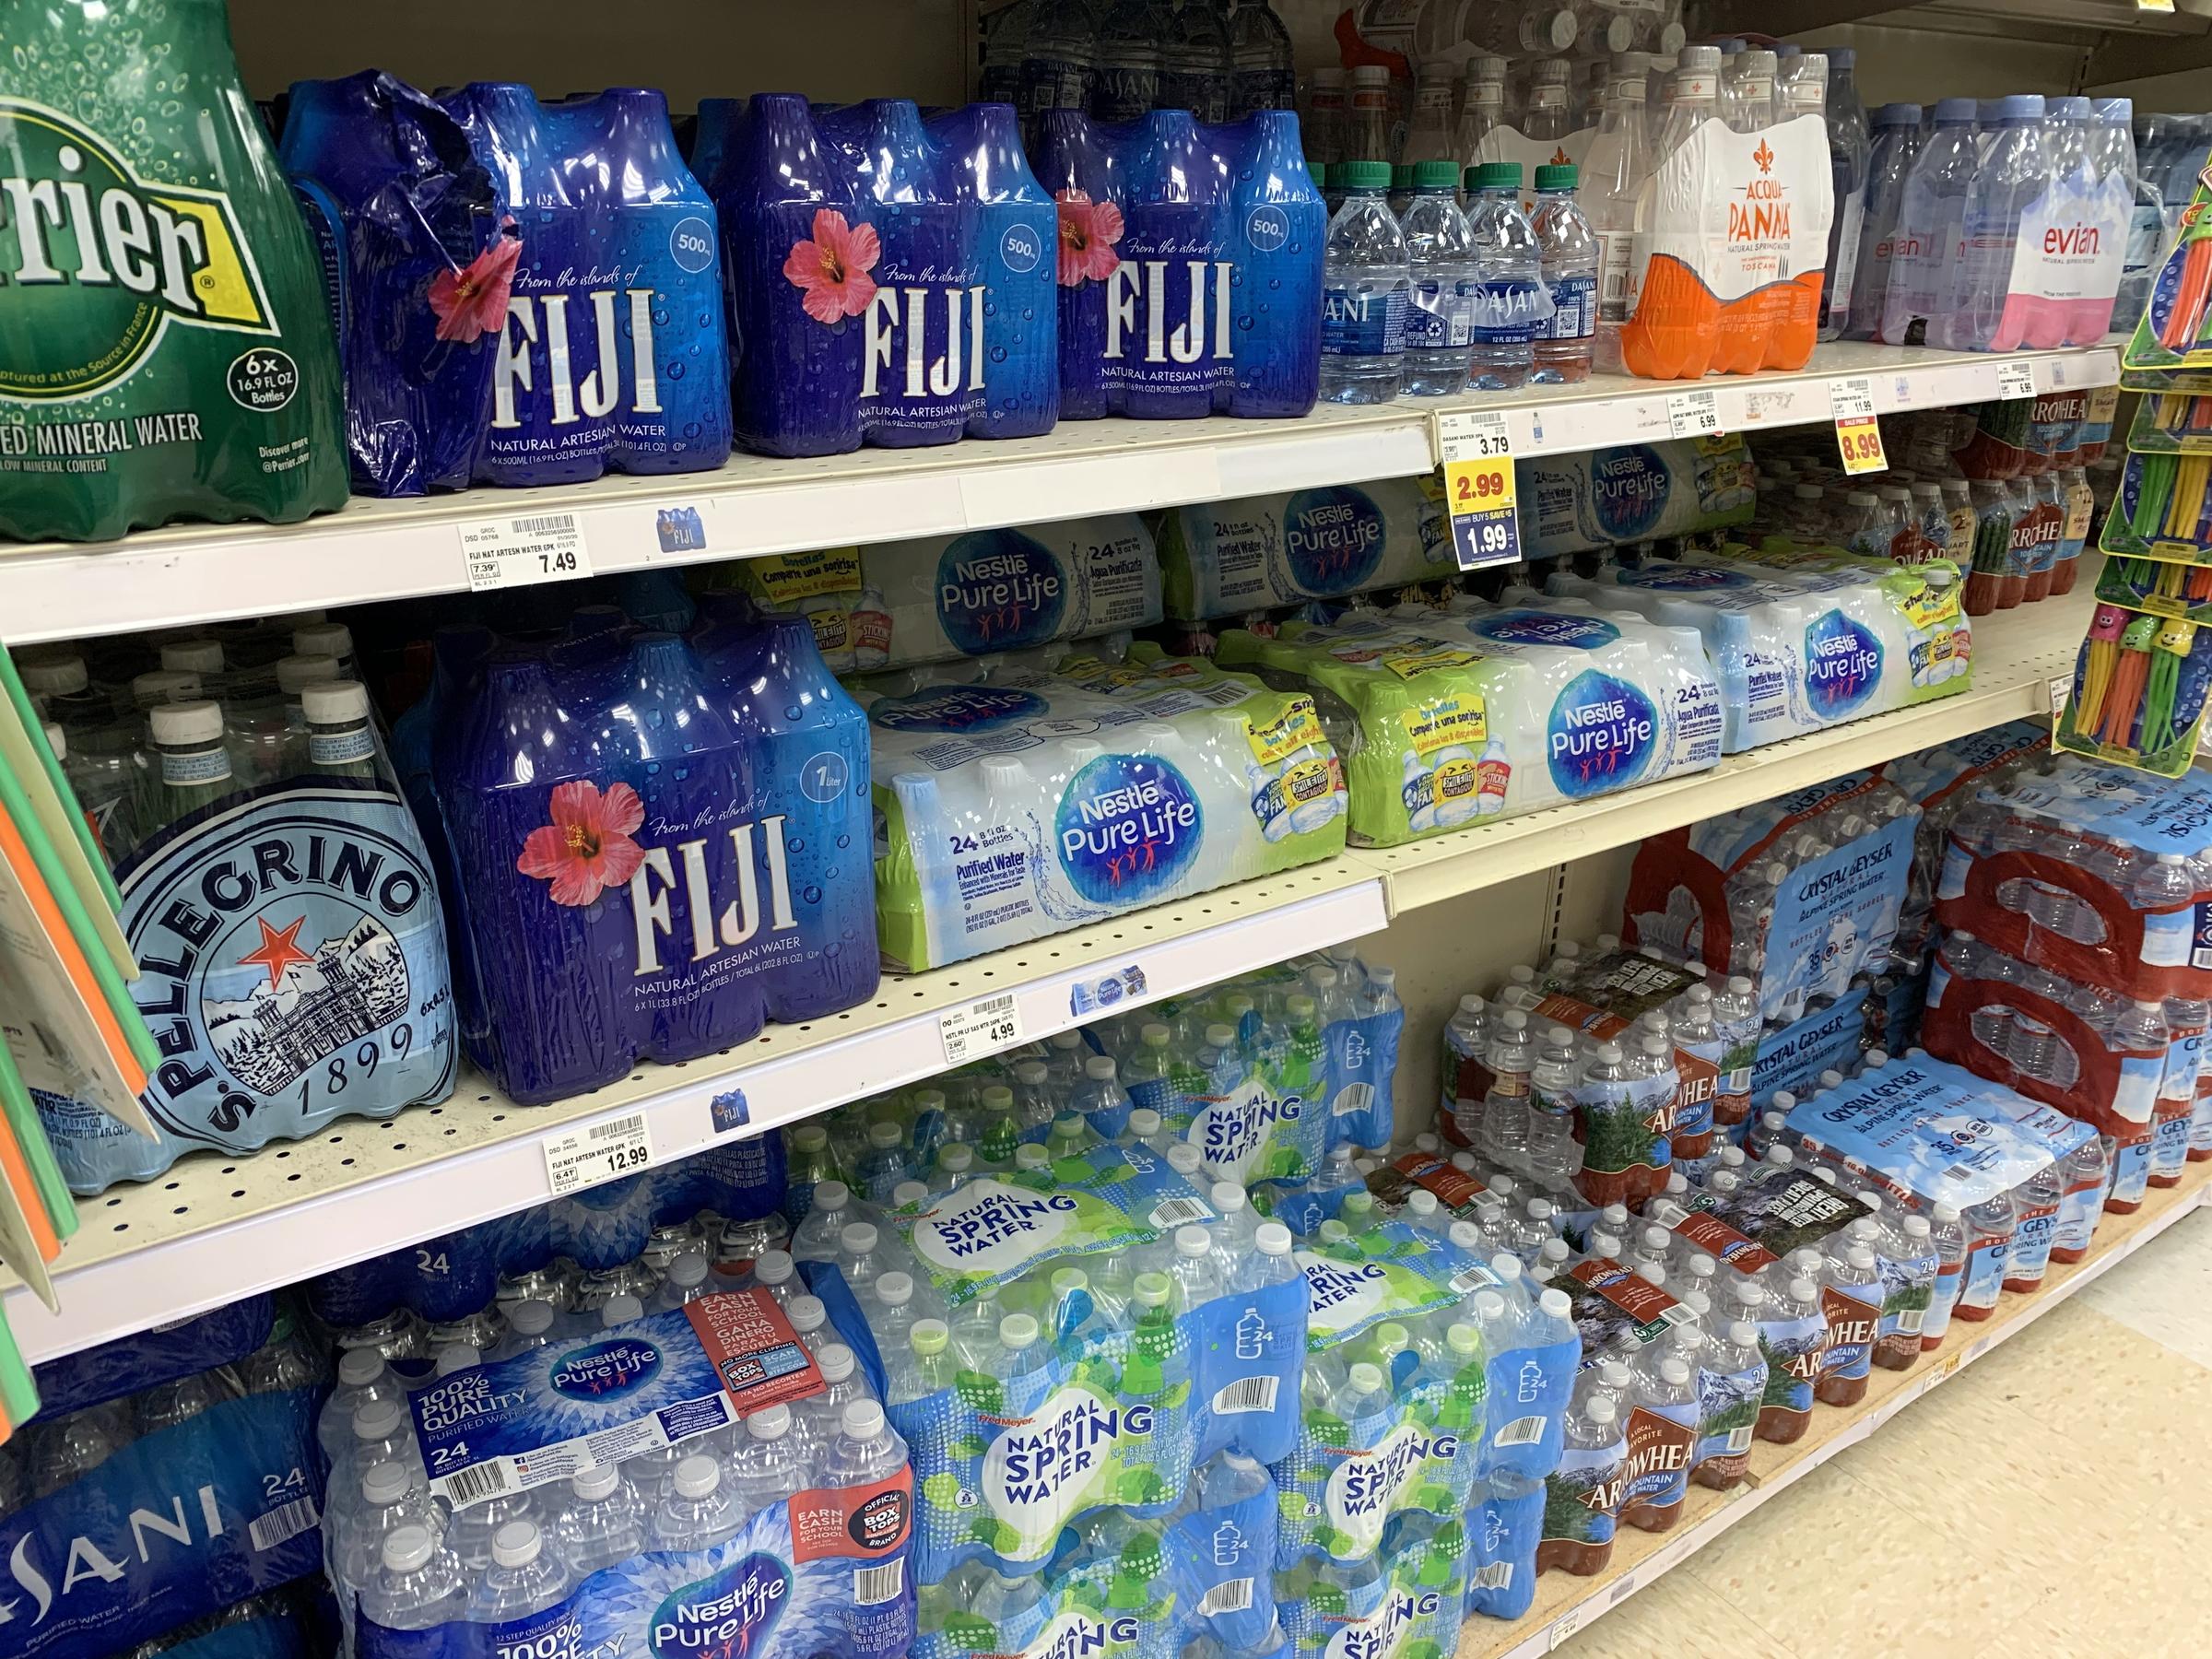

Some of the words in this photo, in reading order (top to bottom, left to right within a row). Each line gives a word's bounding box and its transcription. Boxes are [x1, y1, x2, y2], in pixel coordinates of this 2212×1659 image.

[1747, 181, 1783, 200] ACQUA
[0, 146, 199, 312] rier
[1728, 202, 1791, 242] PANNA
[1126, 238, 1154, 253] From
[1158, 238, 1177, 253] the
[1179, 238, 1211, 255] islands
[2044, 221, 2100, 254] evian
[884, 264, 915, 281] From
[919, 265, 936, 282] the
[1103, 261, 1234, 363] FIJI
[859, 285, 986, 399] FIJI
[49, 372, 64, 383] at
[88, 346, 124, 372] Source
[490, 288, 664, 429] FIJI
[237, 378, 262, 391] 16.9
[265, 376, 276, 388] FL
[277, 372, 293, 385] OZ
[1101, 367, 1146, 381] NATURAL
[1148, 369, 1201, 382] ARTESIAN
[1204, 367, 1234, 379] WATER
[252, 389, 285, 404] Bottles
[2020, 382, 2032, 394] 6.99
[858, 406, 906, 419] NATURAL
[909, 404, 958, 418] ARTESIAN
[959, 397, 986, 412] WATER
[1855, 400, 1872, 412] 11.99
[1700, 415, 1715, 428] 6.99
[36, 419, 133, 455] MINERAL
[135, 413, 203, 446] WATER
[490, 438, 557, 453] NATURAL
[561, 424, 616, 448] ARTESIAN
[618, 424, 666, 439] WATER
[259, 445, 290, 457] Discover
[291, 437, 309, 448] more
[1480, 437, 1509, 455] 3.79
[1842, 432, 1880, 461] 8.99
[23, 460, 65, 473] MINERAL
[66, 459, 107, 473] CONTENT
[1457, 472, 1504, 500] 2.99
[1472, 513, 1485, 523] BUY
[1489, 511, 1505, 520] SAVE
[1214, 523, 1230, 537] 24
[1288, 529, 1341, 555] Pure
[1343, 520, 1380, 553] Life
[1467, 524, 1507, 555] 1.99
[469, 552, 481, 560] FIJI
[482, 550, 495, 559] NAT
[497, 547, 520, 558] ARTESN
[521, 545, 542, 555] WATER
[1088, 543, 1115, 560] 24
[538, 552, 577, 574] 7.49
[943, 582, 1009, 613] Pure
[1014, 572, 1060, 610] Life
[1808, 657, 1849, 682] Pure
[1850, 650, 1878, 682] Life
[1677, 685, 1701, 704] 24
[1565, 700, 1627, 730] Nestlé
[1677, 709, 1693, 724] Agua
[1551, 732, 1609, 759] Pure
[1611, 718, 1652, 755] Life
[1078, 779, 1160, 825] Nestlé
[982, 831, 1014, 849] Bottles
[1061, 815, 1139, 862] Pure
[1142, 799, 1195, 845] Life
[949, 833, 979, 854] 24
[956, 858, 994, 880] Purified
[995, 851, 1025, 872] Water
[629, 815, 798, 977] FIJI
[634, 978, 697, 997] NATURAL
[700, 946, 759, 981] ARTESIAN
[761, 935, 802, 955] WATER
[991, 1022, 1015, 1042] 4.99
[1746, 1019, 1760, 1033] 24
[1355, 1045, 1371, 1056] 24
[300, 1023, 412, 1117] 1899
[1822, 1093, 1881, 1123] CRYSTAL
[1871, 1067, 1928, 1098] GEYSER
[1206, 1096, 1302, 1147] SPRING
[563, 1159, 574, 1168] NAT
[575, 1153, 596, 1164] ARTESN
[596, 1147, 615, 1158] WATER
[607, 1146, 648, 1172] 12.99
[932, 1192, 1020, 1230] NATURAL
[938, 1194, 1077, 1246] SPRING
[948, 1219, 1038, 1259] WATER
[416, 1249, 451, 1276] 24
[1921, 1259, 1936, 1274] 24
[700, 1291, 754, 1307] EARN
[705, 1300, 758, 1314] CASH
[711, 1312, 766, 1329] SCHOOL
[730, 1306, 760, 1317] YOUR
[716, 1319, 771, 1339] GANA
[720, 1325, 775, 1346] DINERO
[1252, 1328, 1274, 1344] 24
[721, 1358, 734, 1368] NO
[735, 1351, 758, 1362] MORE
[759, 1341, 795, 1355] CLIPPING
[726, 1337, 781, 1357] ESCUELA
[764, 1348, 797, 1362] SCAN
[554, 1362, 614, 1388] Pure
[616, 1349, 656, 1381] Life
[728, 1361, 757, 1379] BOX
[735, 1366, 764, 1382] TOPS
[1752, 1366, 1767, 1382] 24
[418, 1373, 489, 1407] 100%
[1529, 1378, 1548, 1390] 24
[421, 1385, 490, 1419] PURE
[423, 1389, 528, 1431] QUALITY
[428, 1418, 485, 1443] PURIFIED
[1007, 1398, 1100, 1453] NATURAL
[1634, 1424, 1653, 1435] LOCAL
[430, 1441, 470, 1465] 24
[1005, 1405, 1154, 1484] SPRING
[1348, 1430, 1419, 1477] NATURAL
[1004, 1450, 1094, 1506] WATER
[1346, 1435, 1458, 1500] SPRING
[263, 1467, 306, 1498] 24
[1343, 1468, 1406, 1518] WATER
[1637, 1483, 1659, 1492] WATER
[798, 1509, 842, 1522] EARN
[799, 1517, 842, 1530] CASH
[864, 1506, 897, 1527] BOX
[800, 1531, 844, 1544] SCHOOL
[869, 1532, 897, 1547] BRAND
[0, 1485, 224, 1628] SANI
[654, 1618, 739, 1648] Pure
[743, 1578, 785, 1626] Life
